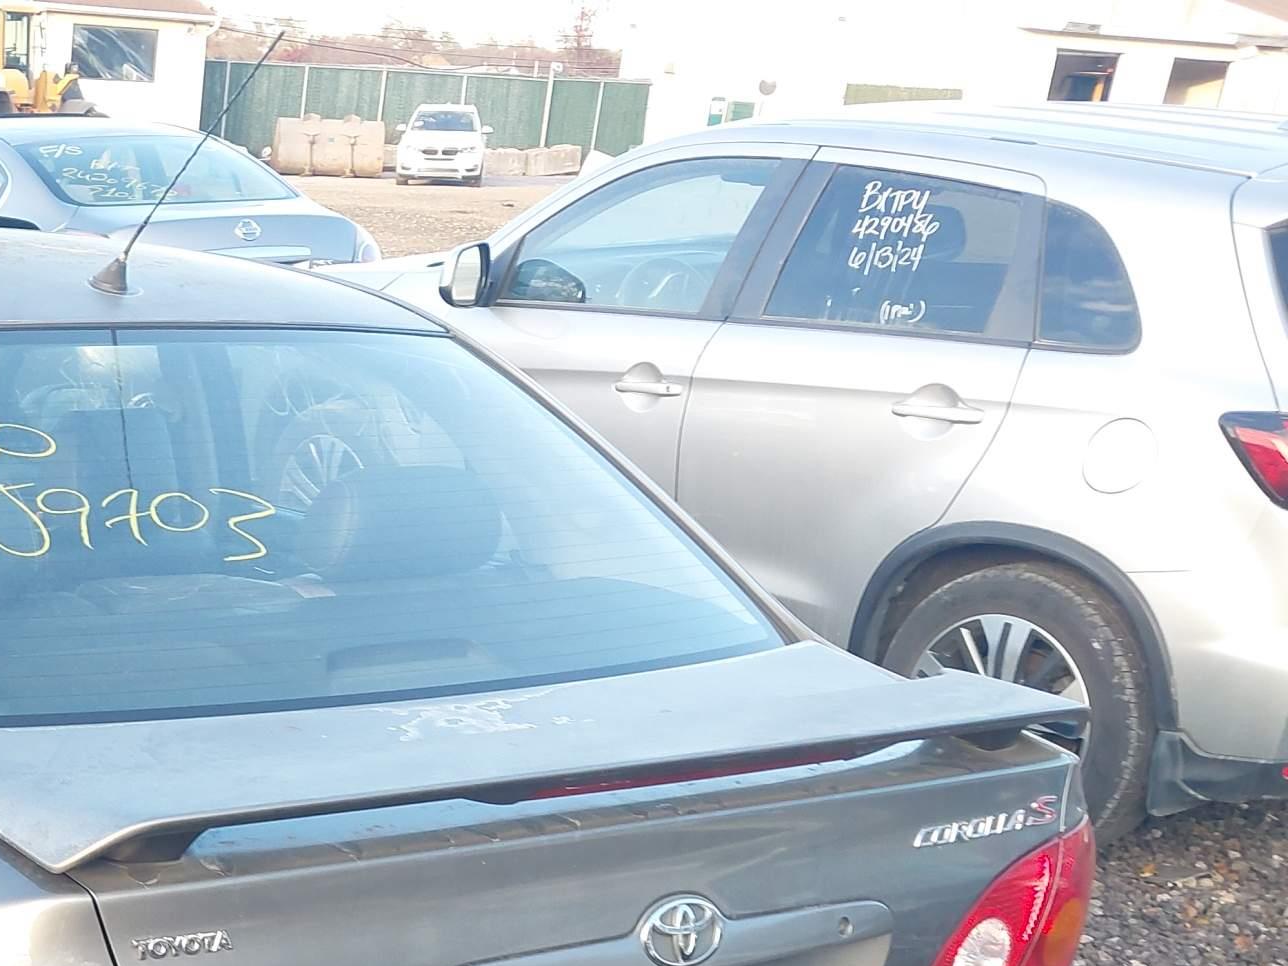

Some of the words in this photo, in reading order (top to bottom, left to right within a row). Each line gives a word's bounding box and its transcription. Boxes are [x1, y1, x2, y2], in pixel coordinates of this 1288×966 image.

[912, 808, 1026, 847] COROLLA
[1024, 796, 1058, 826] S
[131, 929, 233, 960] TOYOTA
